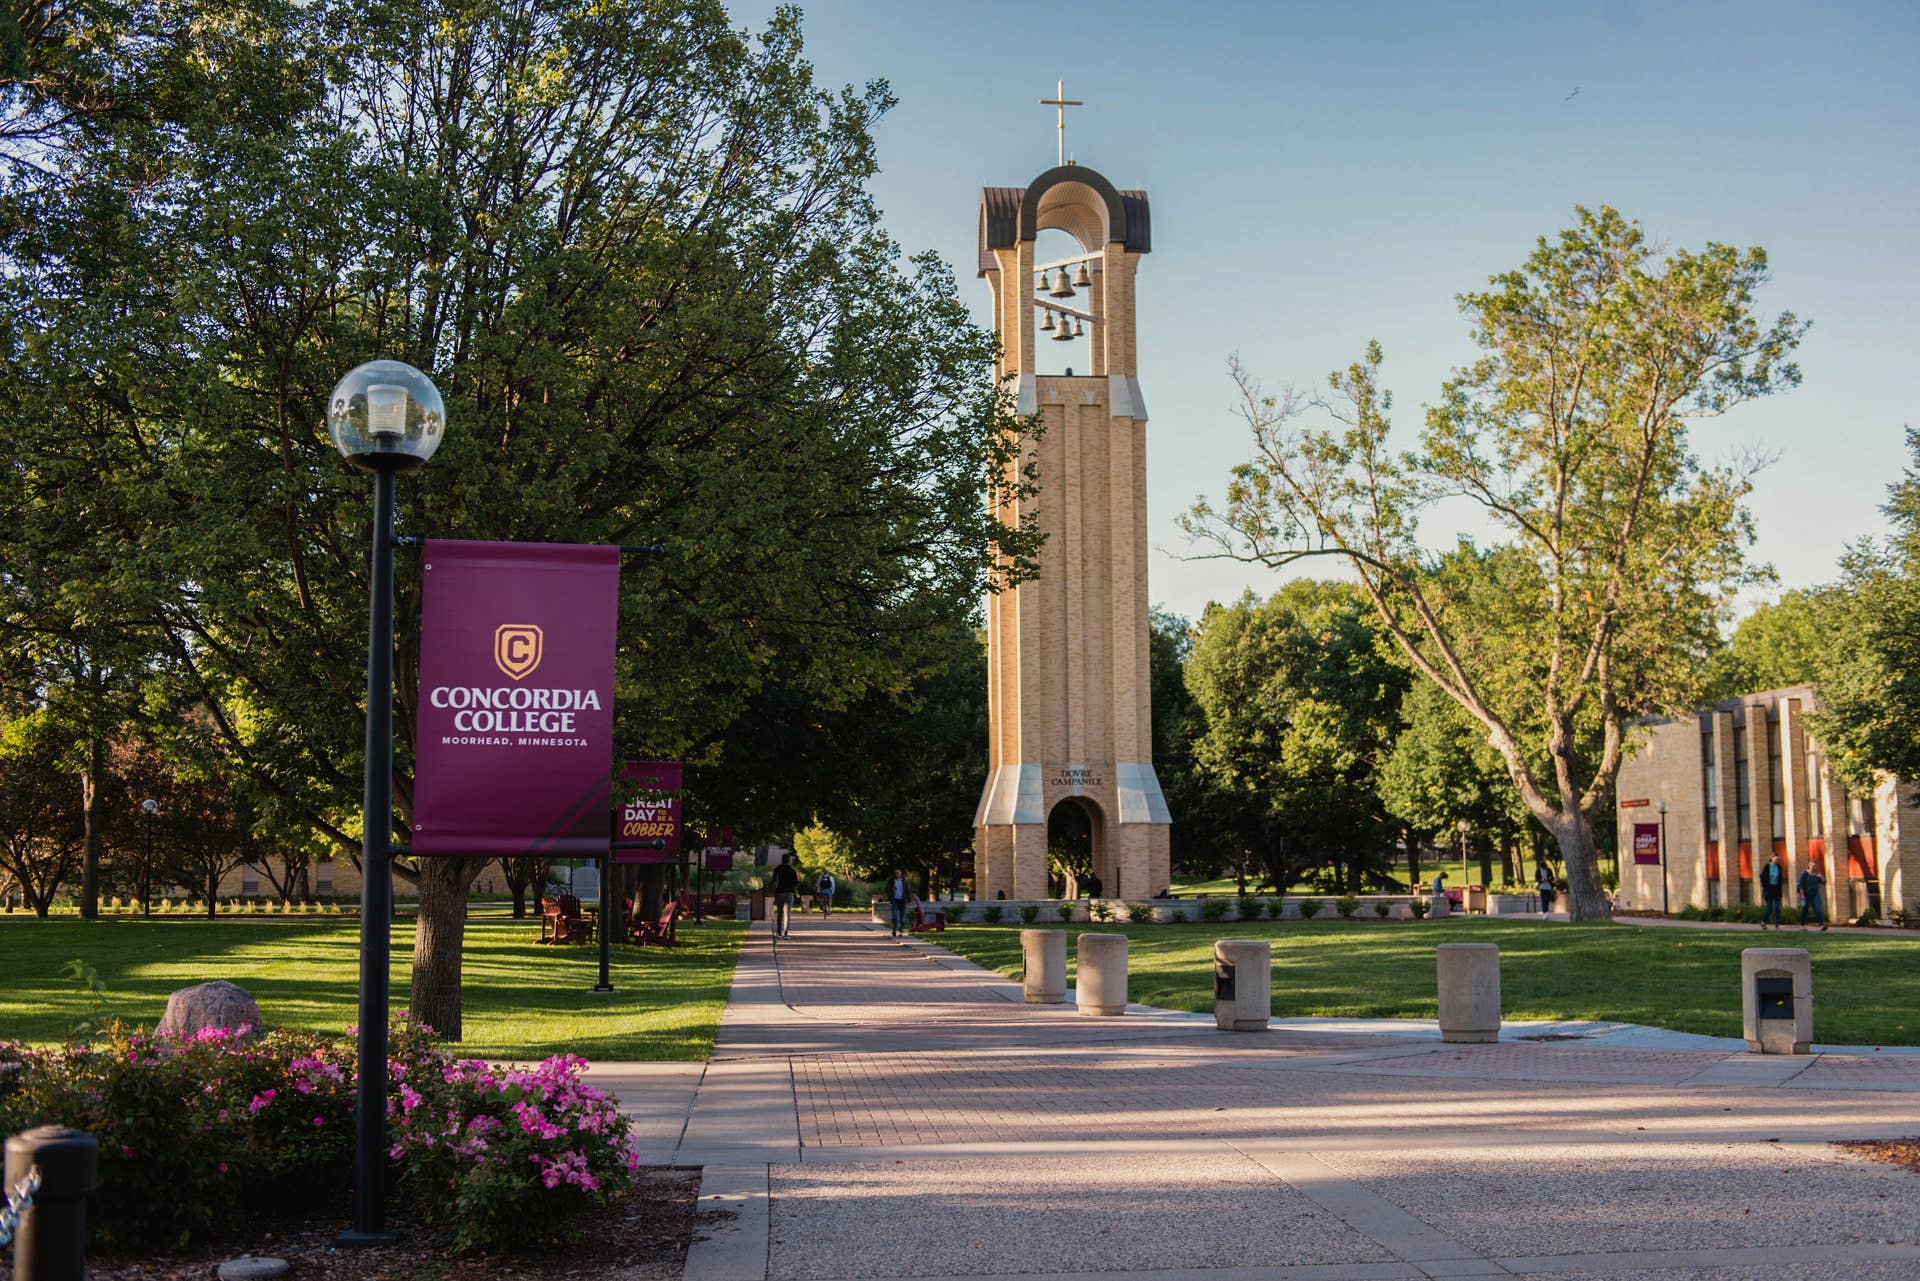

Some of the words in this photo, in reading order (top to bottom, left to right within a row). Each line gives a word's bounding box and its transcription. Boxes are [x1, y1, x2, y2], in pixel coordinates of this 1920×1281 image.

[507, 635, 530, 664] C
[430, 686, 602, 711] CONCORDIA
[454, 710, 576, 733] COLLEGE
[442, 736, 513, 746] MOORHEAD,
[518, 737, 588, 747] MINNESOTA
[1061, 769, 1093, 778] DOVRE
[1051, 777, 1103, 786] CAMPANILE
[625, 809, 656, 821] DAY
[623, 822, 675, 837] COBBER
